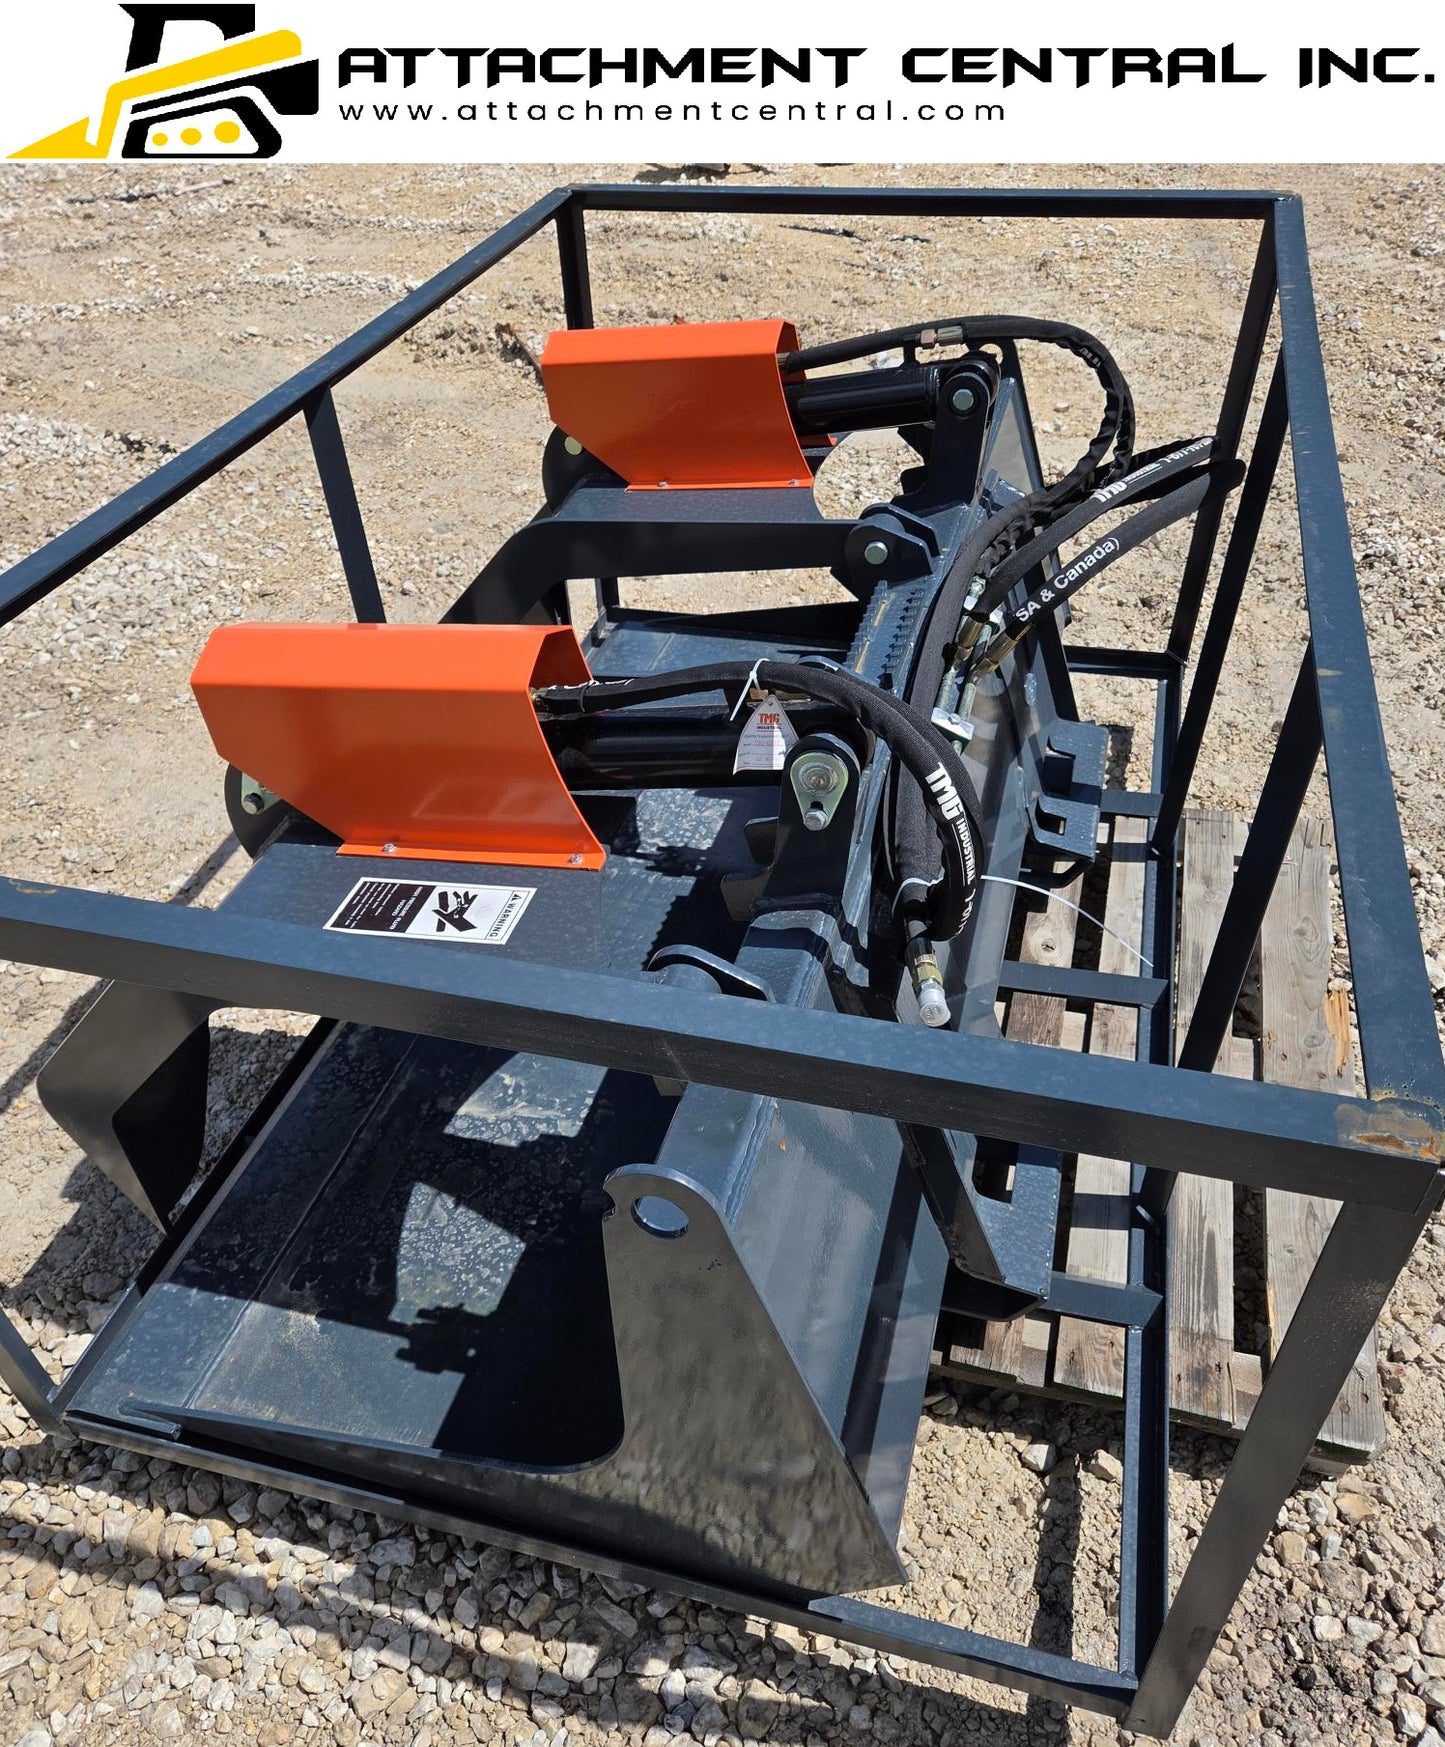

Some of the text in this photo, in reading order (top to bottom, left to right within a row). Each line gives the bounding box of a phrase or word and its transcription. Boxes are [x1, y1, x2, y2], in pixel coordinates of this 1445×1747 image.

[1039, 588, 1056, 603] &
[1053, 536, 1121, 590] Canada)
[758, 713, 780, 724] TMG
[925, 761, 966, 821] TMG
[955, 819, 977, 886] INDUSTRIAL
[391, 899, 407, 917] HAZARD
[489, 902, 517, 938] WARNING
